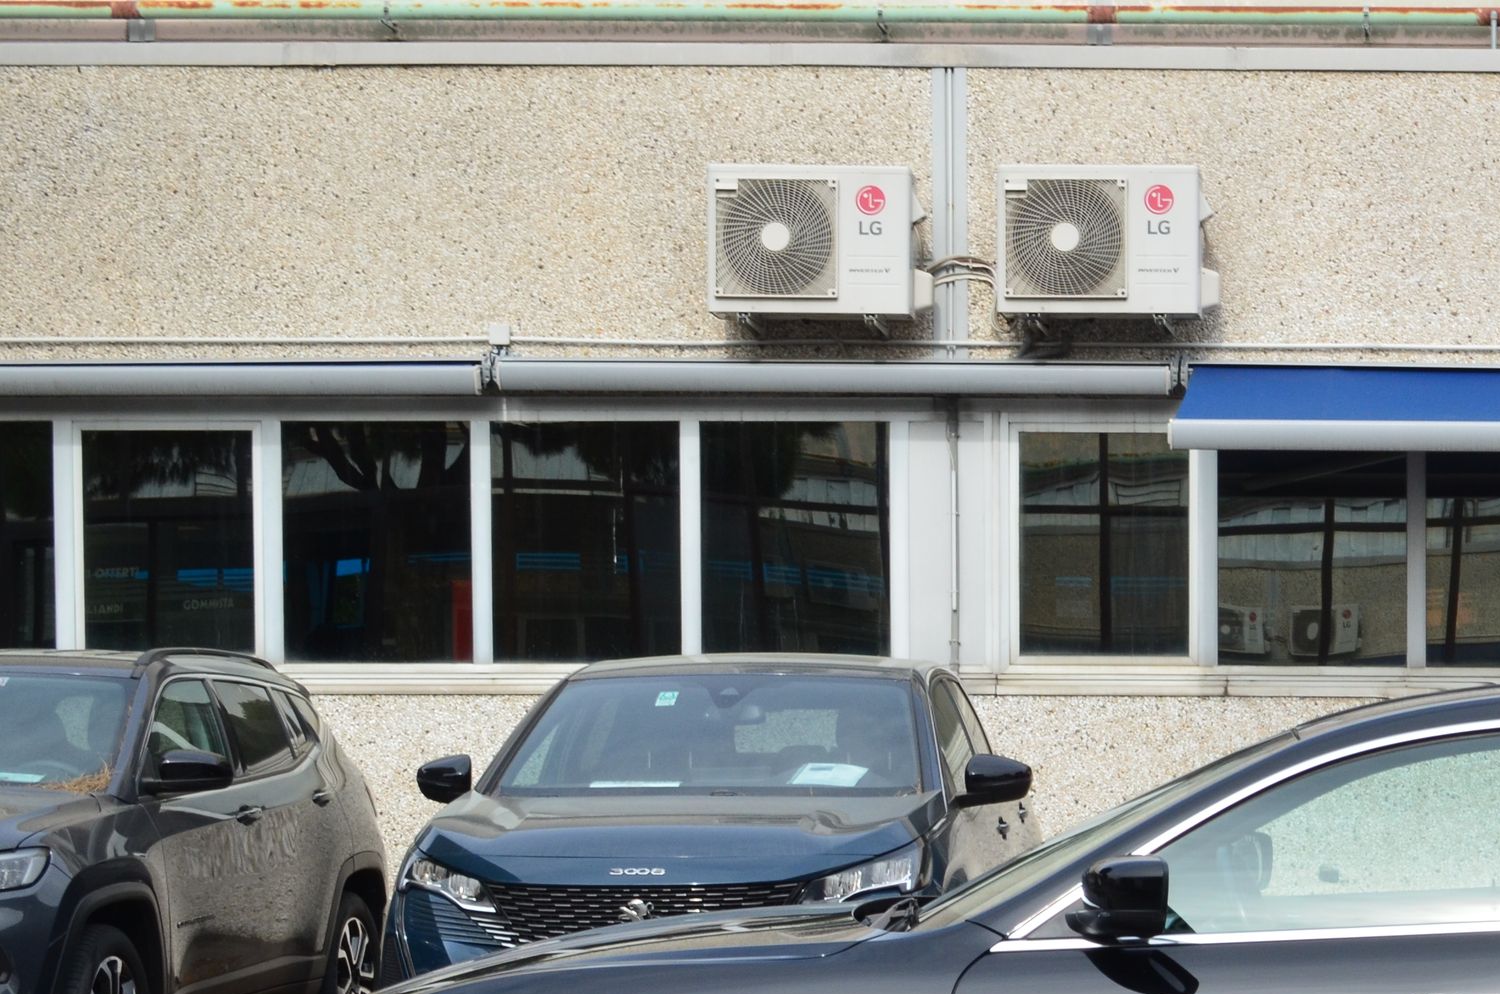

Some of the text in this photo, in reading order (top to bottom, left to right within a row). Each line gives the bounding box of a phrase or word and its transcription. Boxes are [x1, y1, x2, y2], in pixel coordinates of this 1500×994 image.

[859, 221, 882, 235] LG
[1147, 220, 1171, 235] LG
[609, 868, 666, 876] 3008
